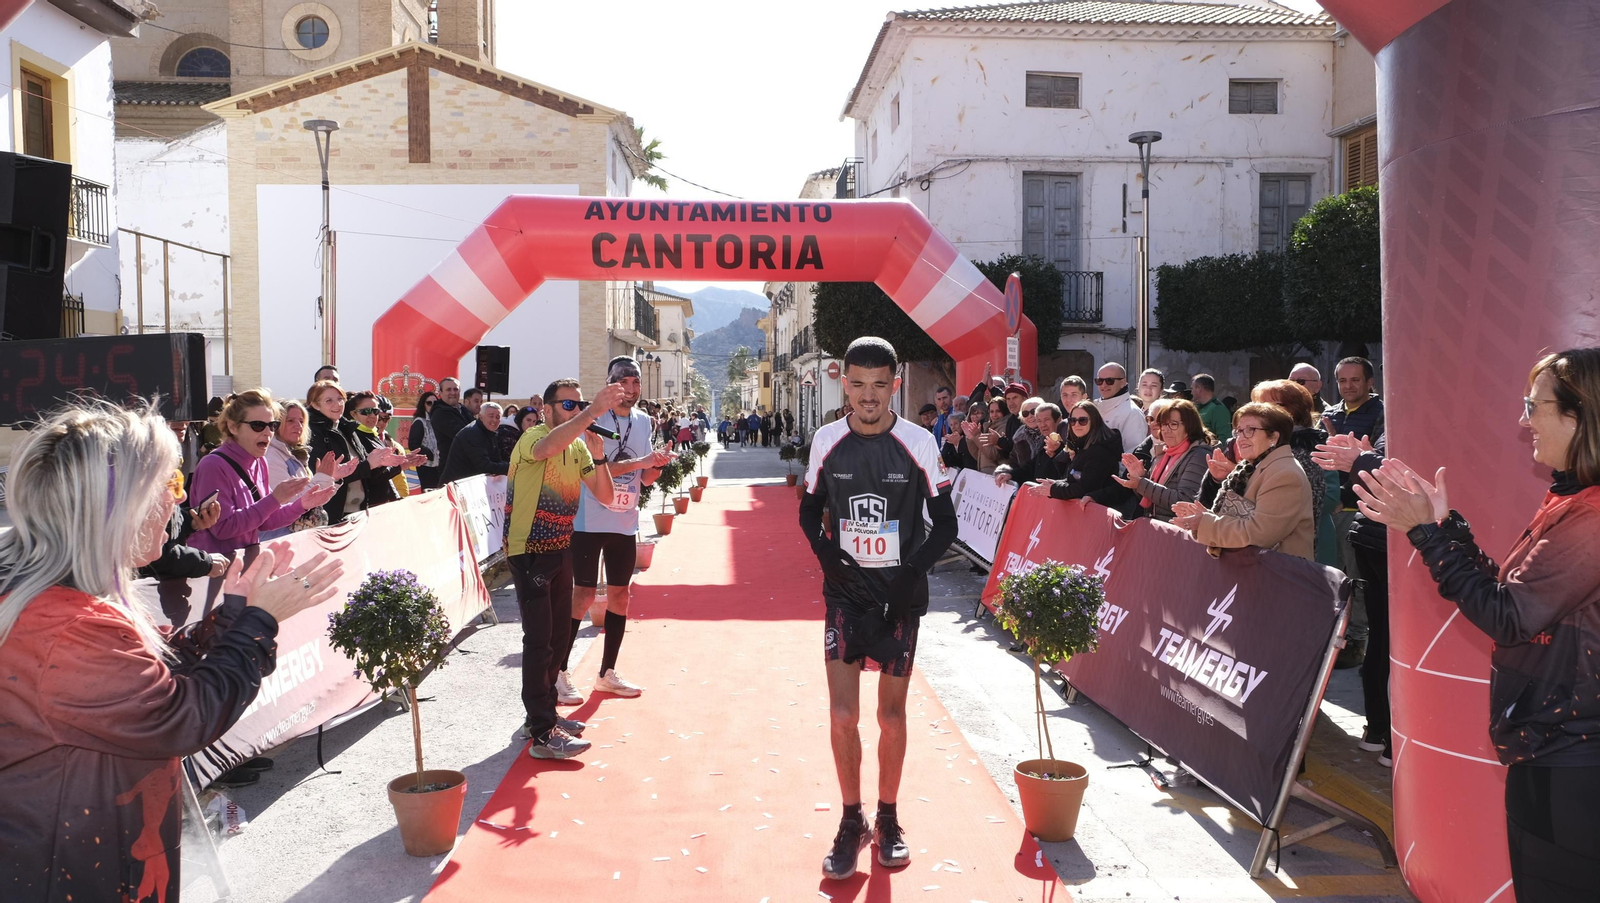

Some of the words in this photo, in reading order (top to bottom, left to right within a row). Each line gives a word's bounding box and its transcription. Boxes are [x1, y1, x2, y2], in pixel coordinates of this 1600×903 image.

[584, 201, 832, 223] AYUNTAMIENTO
[591, 232, 824, 270] CANTORIA
[852, 536, 887, 556] 110
[1152, 627, 1268, 704] TEAMERGY
